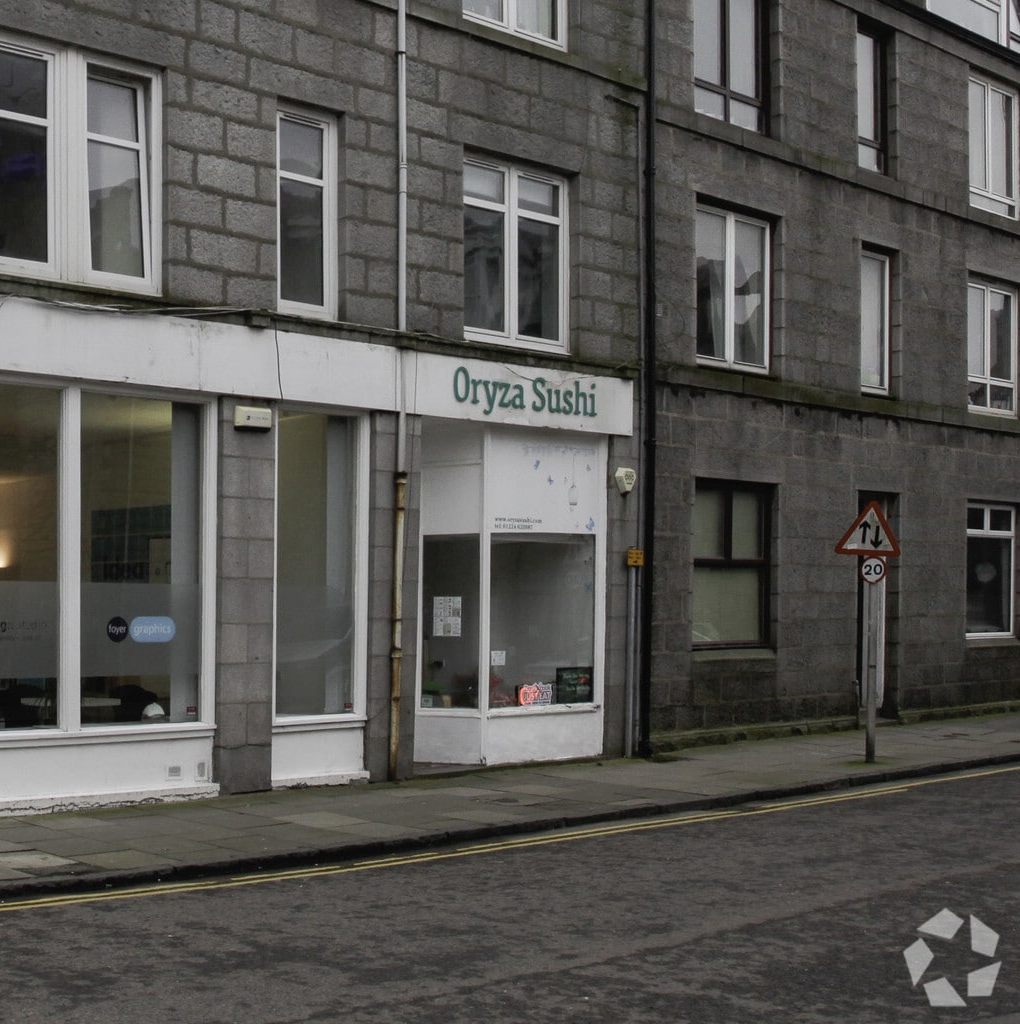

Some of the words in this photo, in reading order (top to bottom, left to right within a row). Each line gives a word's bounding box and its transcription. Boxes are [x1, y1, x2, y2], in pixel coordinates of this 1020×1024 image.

[453, 366, 525, 415] Oryza
[531, 377, 597, 417] Sushi
[864, 564, 883, 576] 20
[108, 624, 126, 635] foyer
[133, 623, 171, 636] graphics
